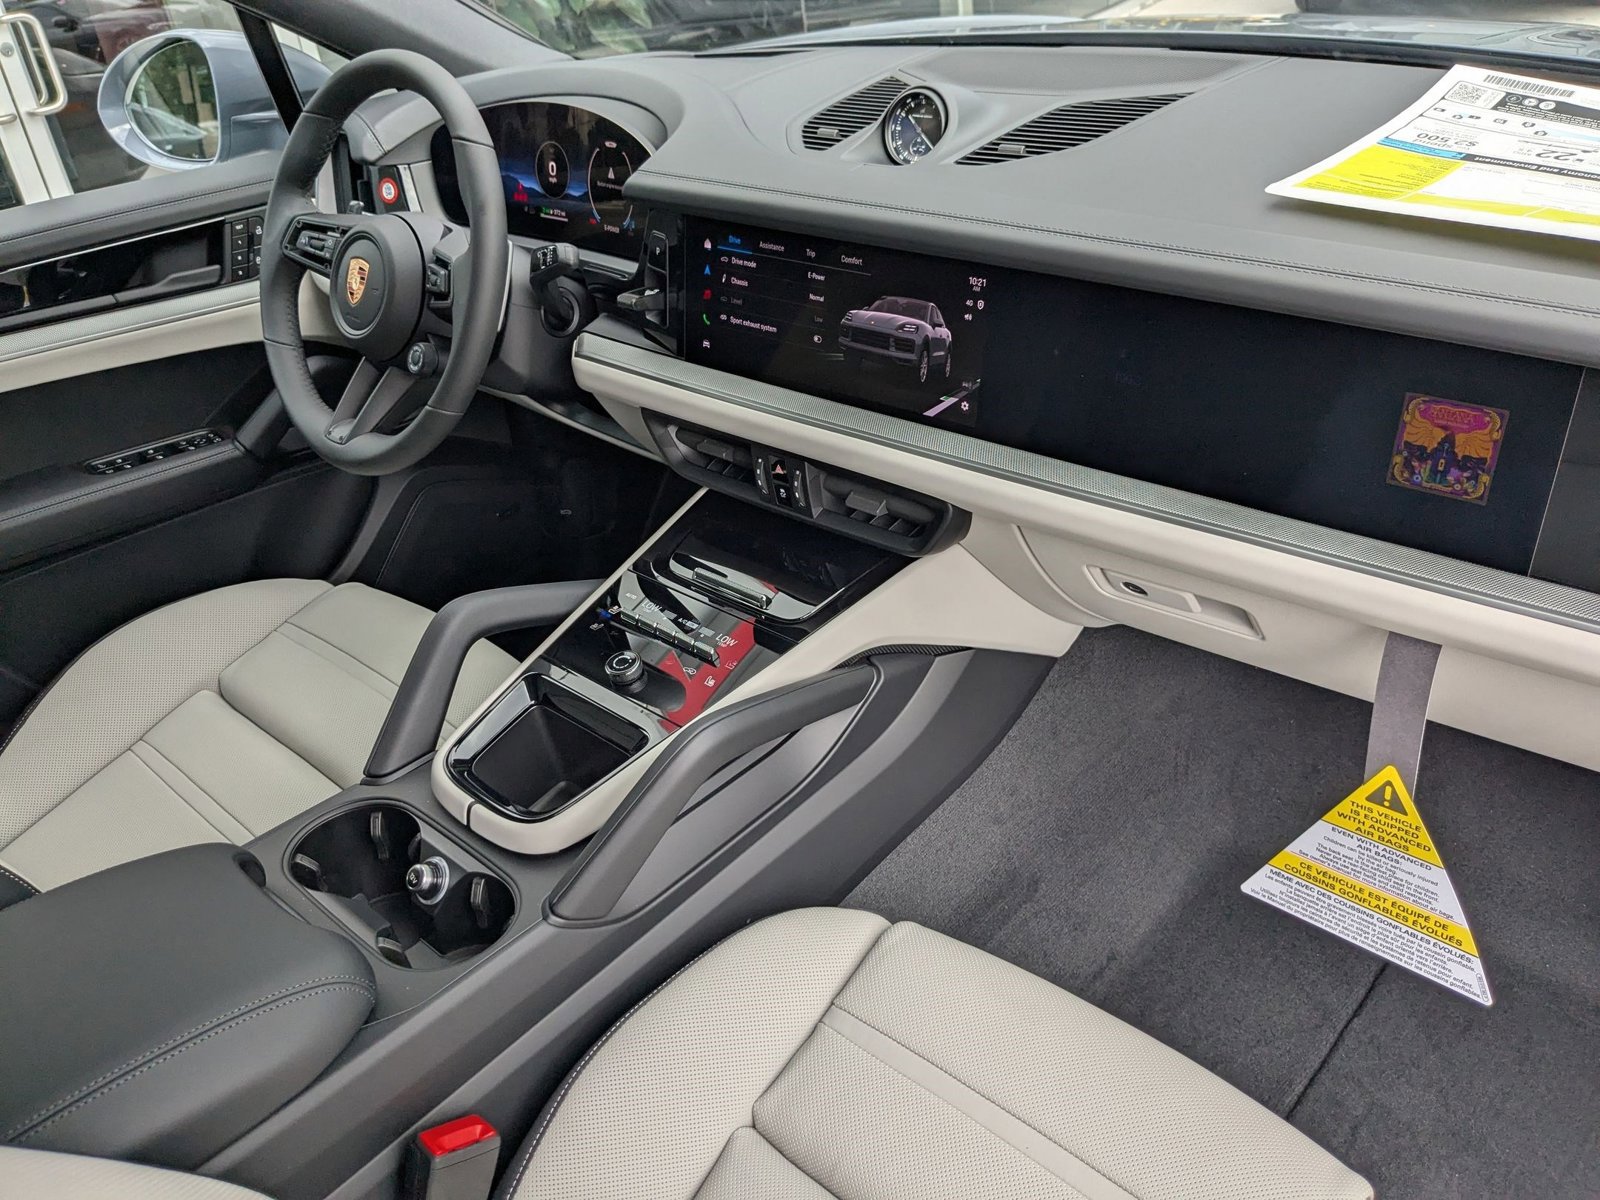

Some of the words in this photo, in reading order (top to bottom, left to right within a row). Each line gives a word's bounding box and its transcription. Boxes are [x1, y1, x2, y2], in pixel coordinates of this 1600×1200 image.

[1474, 156, 1538, 170] Environment
[728, 234, 741, 244] Drive
[760, 241, 784, 252] Assistance
[806, 248, 816, 258] Trip
[840, 254, 862, 266] Comfort
[731, 257, 743, 266] Drive
[744, 260, 757, 268] mode
[730, 276, 748, 287] Chassis
[808, 272, 826, 281] E-Power
[968, 276, 986, 287] 10:21
[809, 293, 825, 302] Normal
[730, 316, 742, 325] Sport
[743, 320, 760, 329] exhaust
[761, 324, 778, 333] system
[641, 600, 662, 612] LOW
[716, 633, 738, 646] LOW
[1349, 800, 1374, 814] THIS
[1375, 810, 1422, 832] VEHICLE
[1349, 808, 1360, 816] IS
[1363, 813, 1419, 839] EQUIPPED
[1336, 810, 1365, 826] WITH
[1368, 823, 1431, 852] ADVANCED
[1354, 825, 1374, 838] AIR
[1377, 834, 1409, 852] BAGS
[1330, 826, 1354, 840] EVEN
[1355, 836, 1379, 850] WITH
[1381, 846, 1432, 871] ADVANCED
[1356, 843, 1372, 853] AIR
[1373, 850, 1402, 866] BAGS:
[1283, 862, 1335, 890] COUSSINS
[1338, 886, 1409, 923] GONFLABLES
[1411, 918, 1463, 947] ÉVOLUÉS
[1298, 861, 1312, 872] CE
[1314, 867, 1364, 894] VÉHICULE
[1367, 890, 1388, 905] EST
[1390, 900, 1430, 923] ÉQUIPÉ
[1433, 919, 1449, 932] DE
[1269, 868, 1293, 883] MÊME
[1294, 879, 1315, 893] AVEC
[1316, 889, 1332, 900] DES
[1333, 897, 1375, 920] COUSSINS
[1376, 916, 1431, 945] GONFLABLES
[1432, 941, 1474, 964] ÉVOLUÉS:
